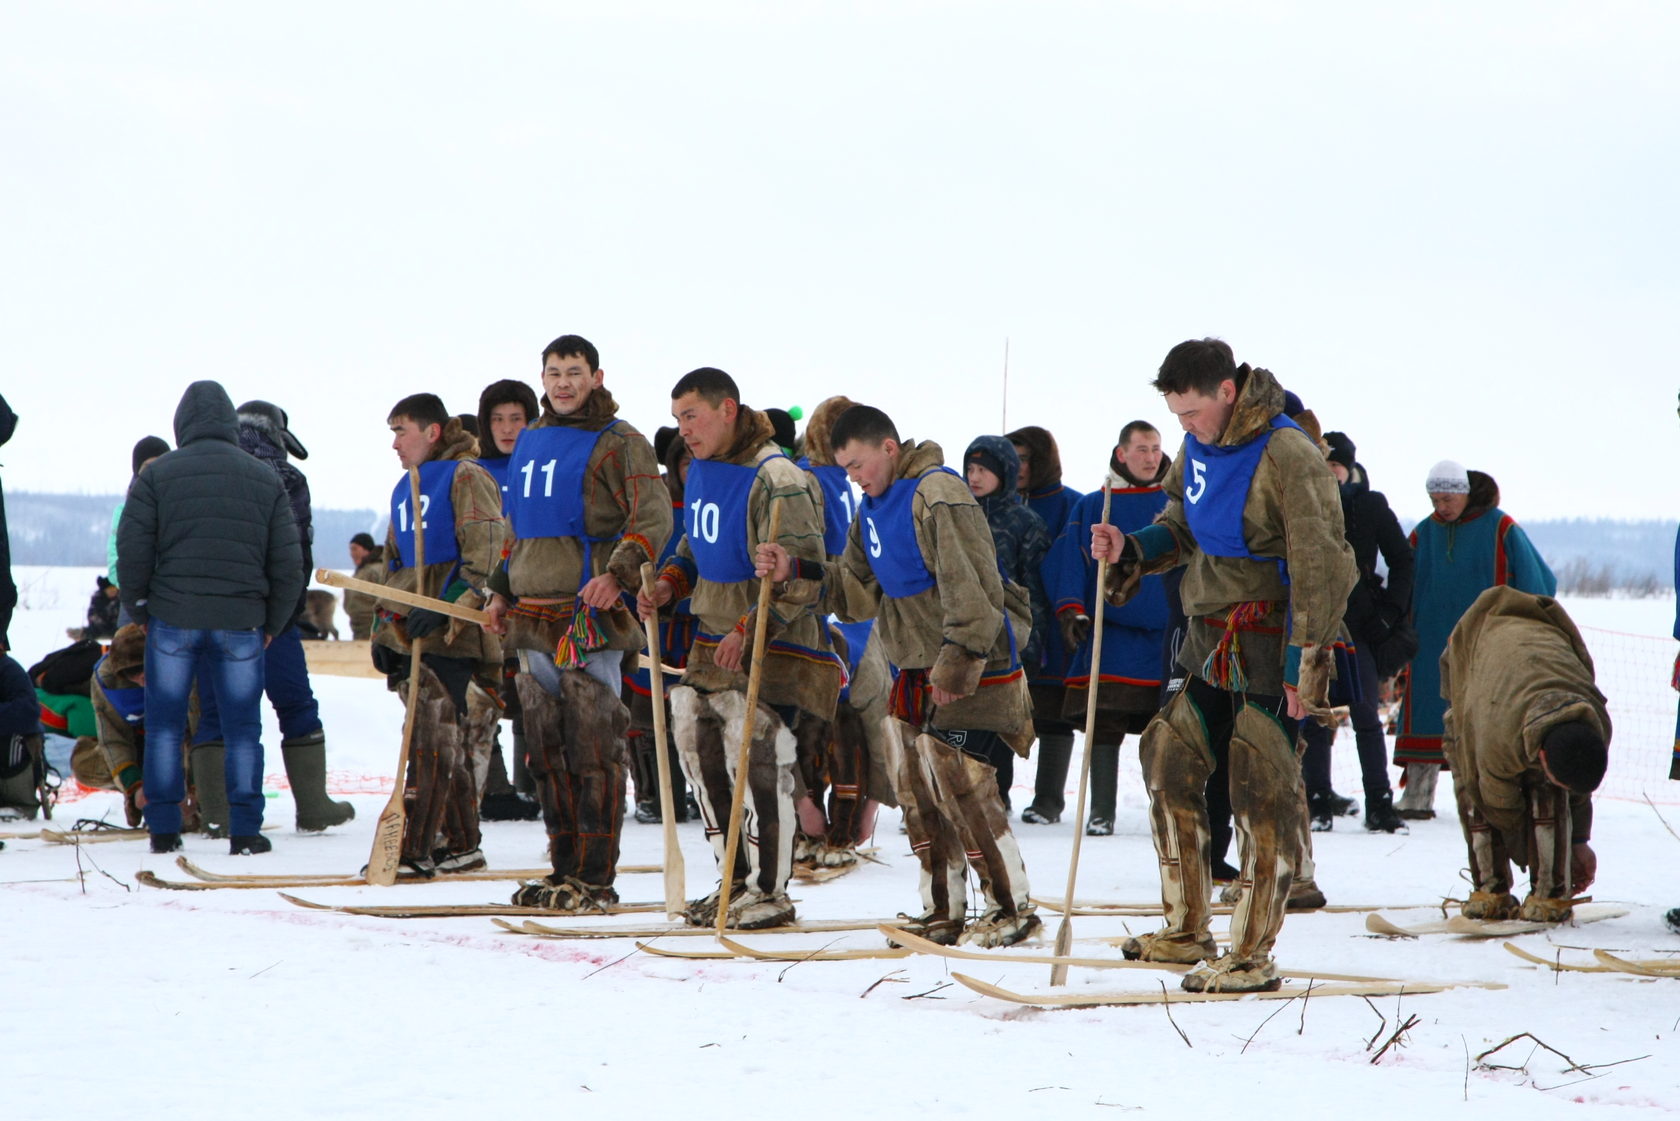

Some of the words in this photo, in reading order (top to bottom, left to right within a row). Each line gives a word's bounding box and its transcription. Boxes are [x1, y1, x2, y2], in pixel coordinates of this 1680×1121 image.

[521, 459, 557, 498] 11
[1186, 459, 1206, 504] 5
[397, 495, 430, 532] 12
[691, 498, 720, 544] 10
[866, 517, 882, 558] 9
